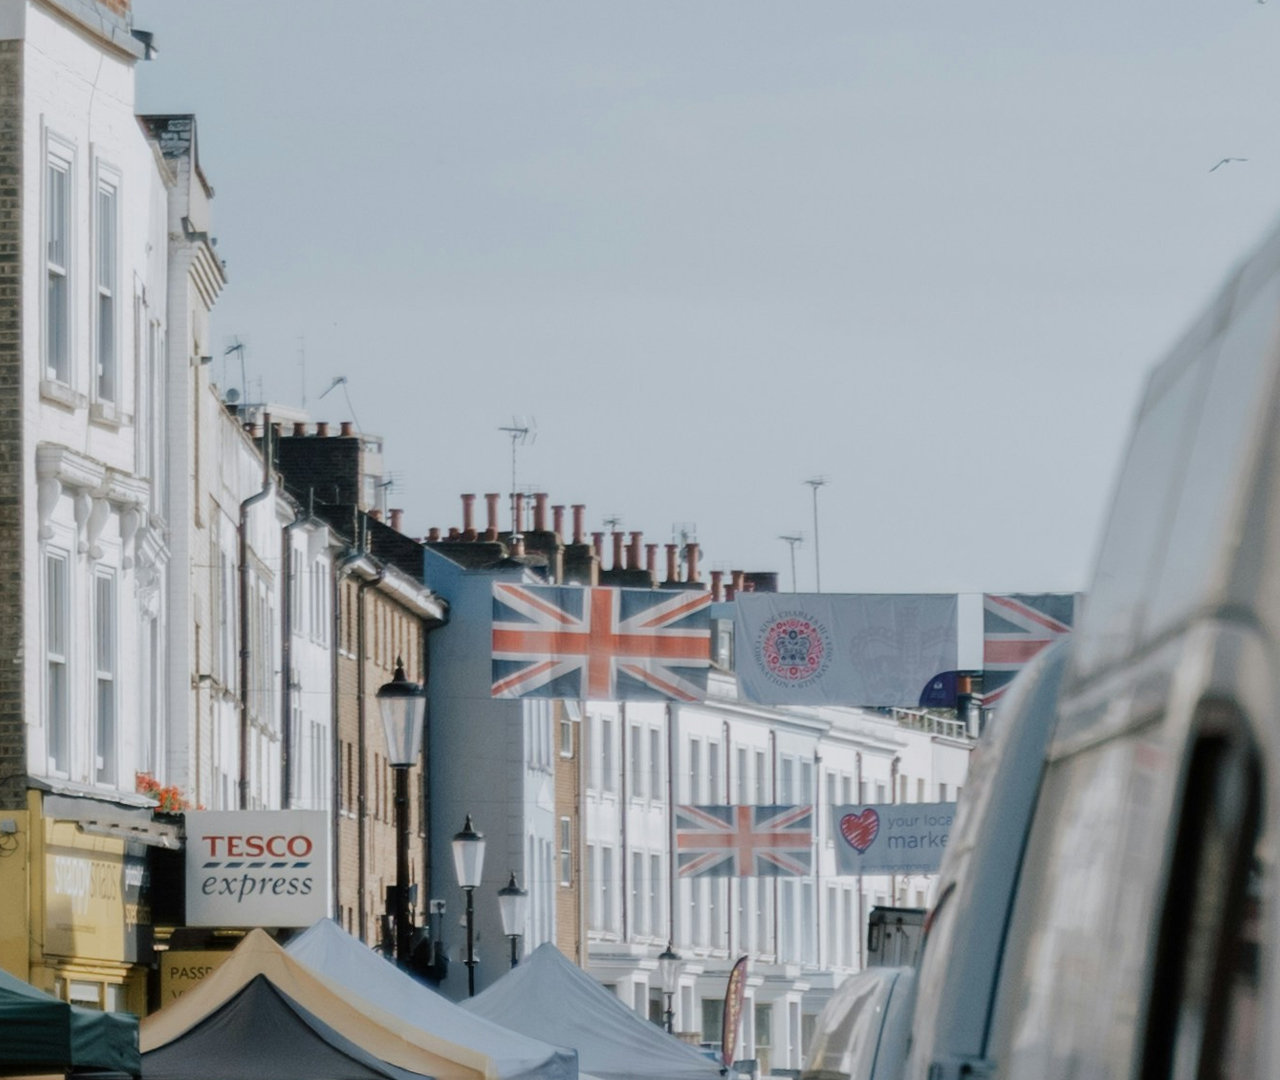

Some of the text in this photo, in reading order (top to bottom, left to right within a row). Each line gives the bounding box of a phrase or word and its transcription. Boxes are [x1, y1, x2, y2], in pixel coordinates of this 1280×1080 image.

[888, 814, 953, 829] your loca
[202, 835, 313, 858] TESCO
[888, 831, 950, 849] marke
[202, 873, 313, 903] express
